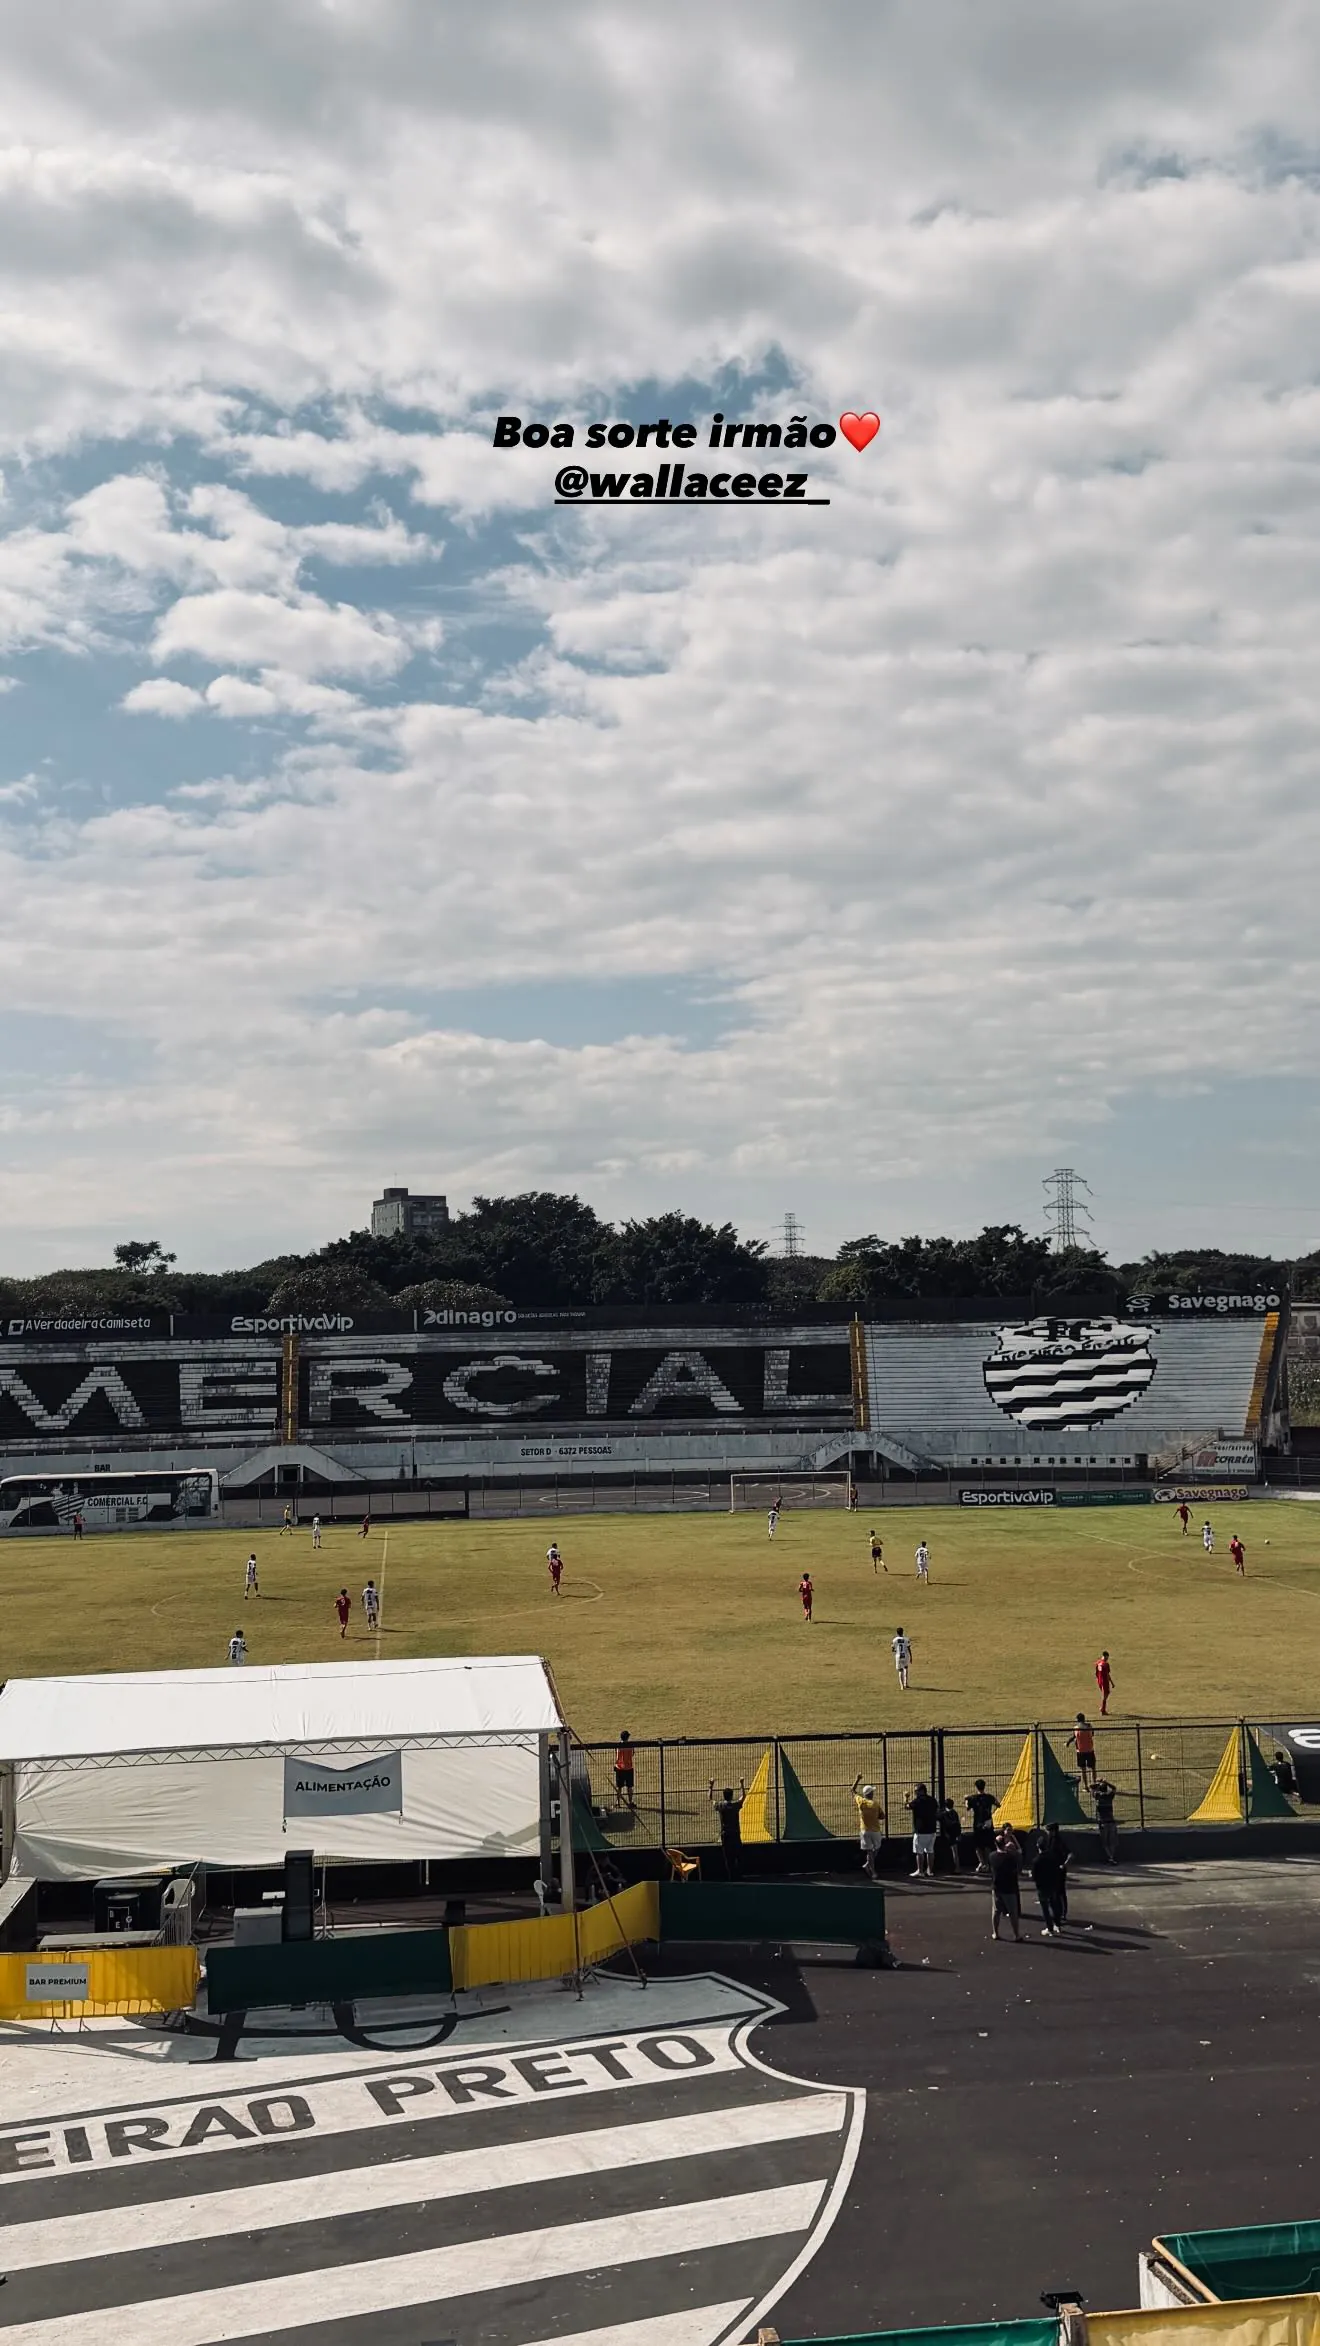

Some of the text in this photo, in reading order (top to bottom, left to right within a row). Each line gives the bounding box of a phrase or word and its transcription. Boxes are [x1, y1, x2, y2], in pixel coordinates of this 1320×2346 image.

[1168, 1294, 1280, 1312] Savegnago
[0, 1350, 853, 1430] MERCIAL
[521, 1447, 544, 1456] SETOR
[579, 1446, 613, 1455] PESSOAS
[94, 1464, 111, 1472] BAR
[962, 1490, 1054, 1504] EsportivaVip
[1176, 1487, 1247, 1501] Savegnago
[87, 1496, 135, 1507] COMERCIAL
[295, 1775, 391, 1793] ALIMENTAÇÃO
[363, 2035, 716, 2117] PRETO
